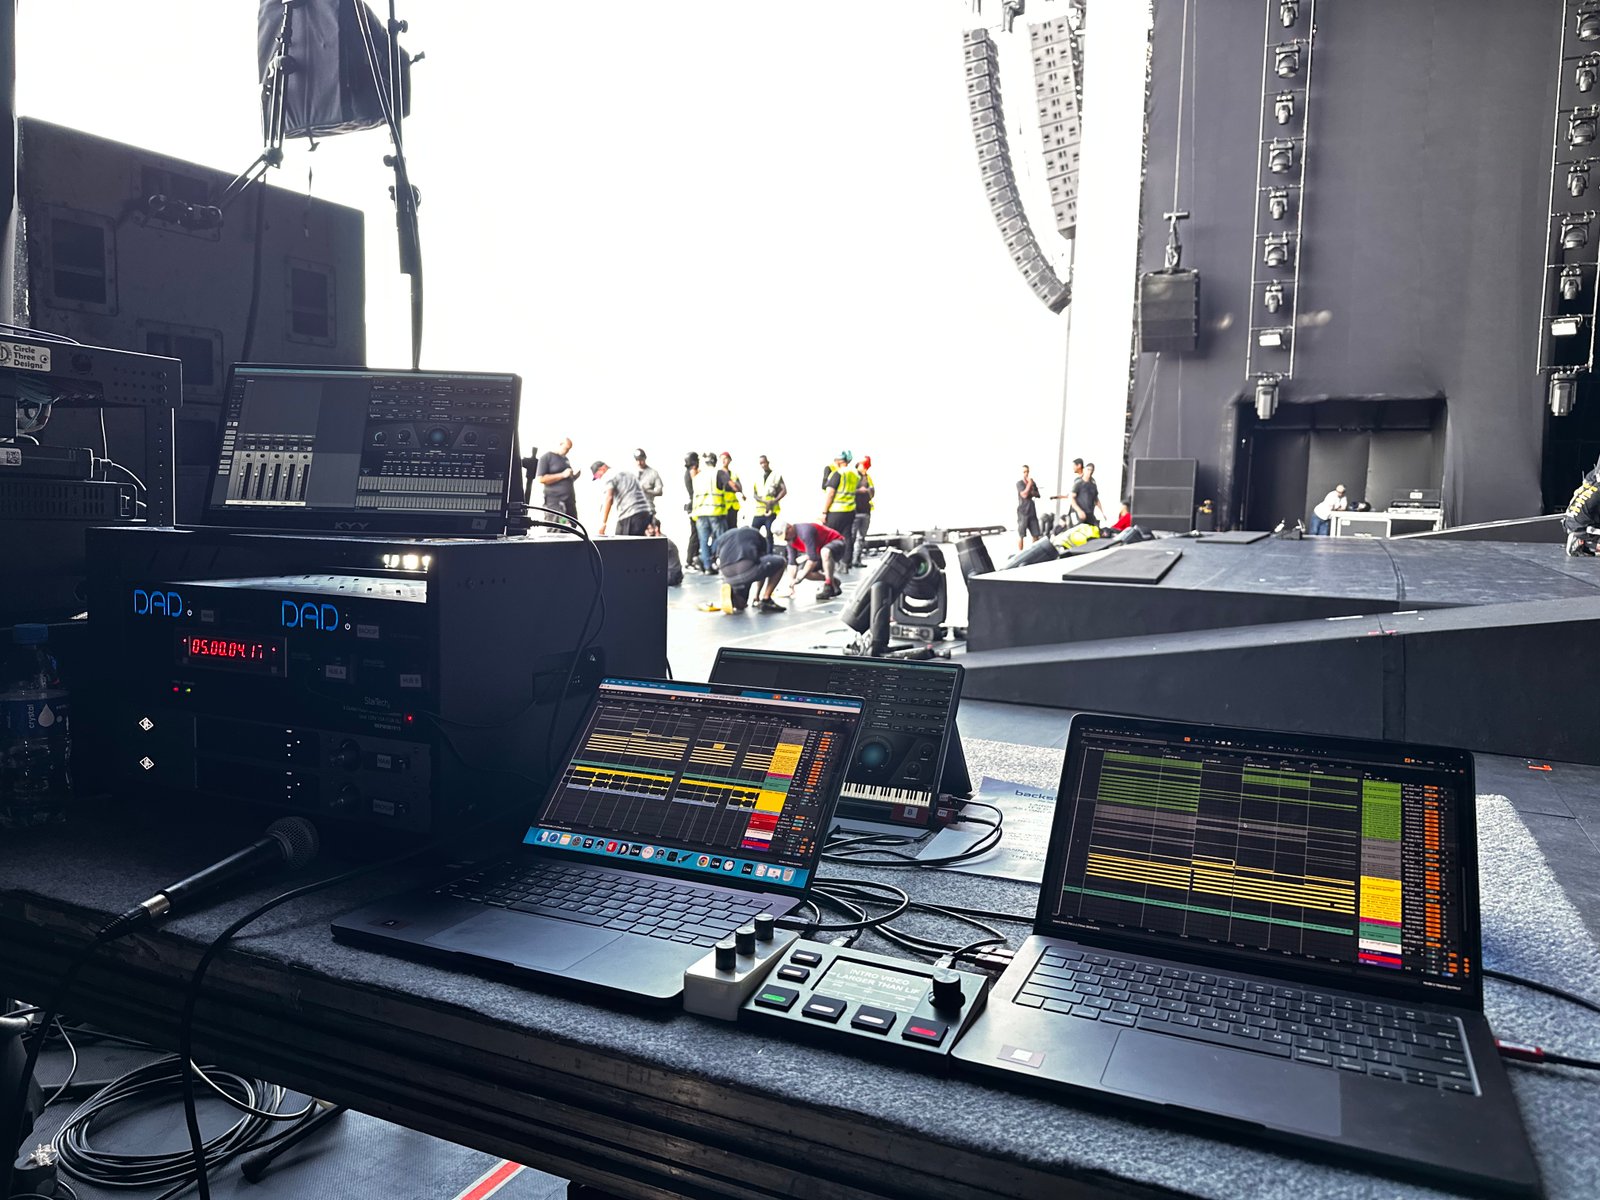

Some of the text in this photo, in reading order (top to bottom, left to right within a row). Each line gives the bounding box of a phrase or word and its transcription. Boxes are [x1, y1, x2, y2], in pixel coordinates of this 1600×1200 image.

[13, 344, 36, 354] Circle
[13, 352, 36, 361] Three
[14, 359, 43, 369] Designs
[335, 521, 369, 530] KYY
[133, 588, 183, 618] DAD
[281, 600, 340, 631] DAD
[27, 704, 37, 729] crystal
[836, 972, 876, 986] LARGER
[877, 980, 904, 993] THAN
[849, 968, 879, 980] INTRO
[880, 974, 910, 986] VIDEO
